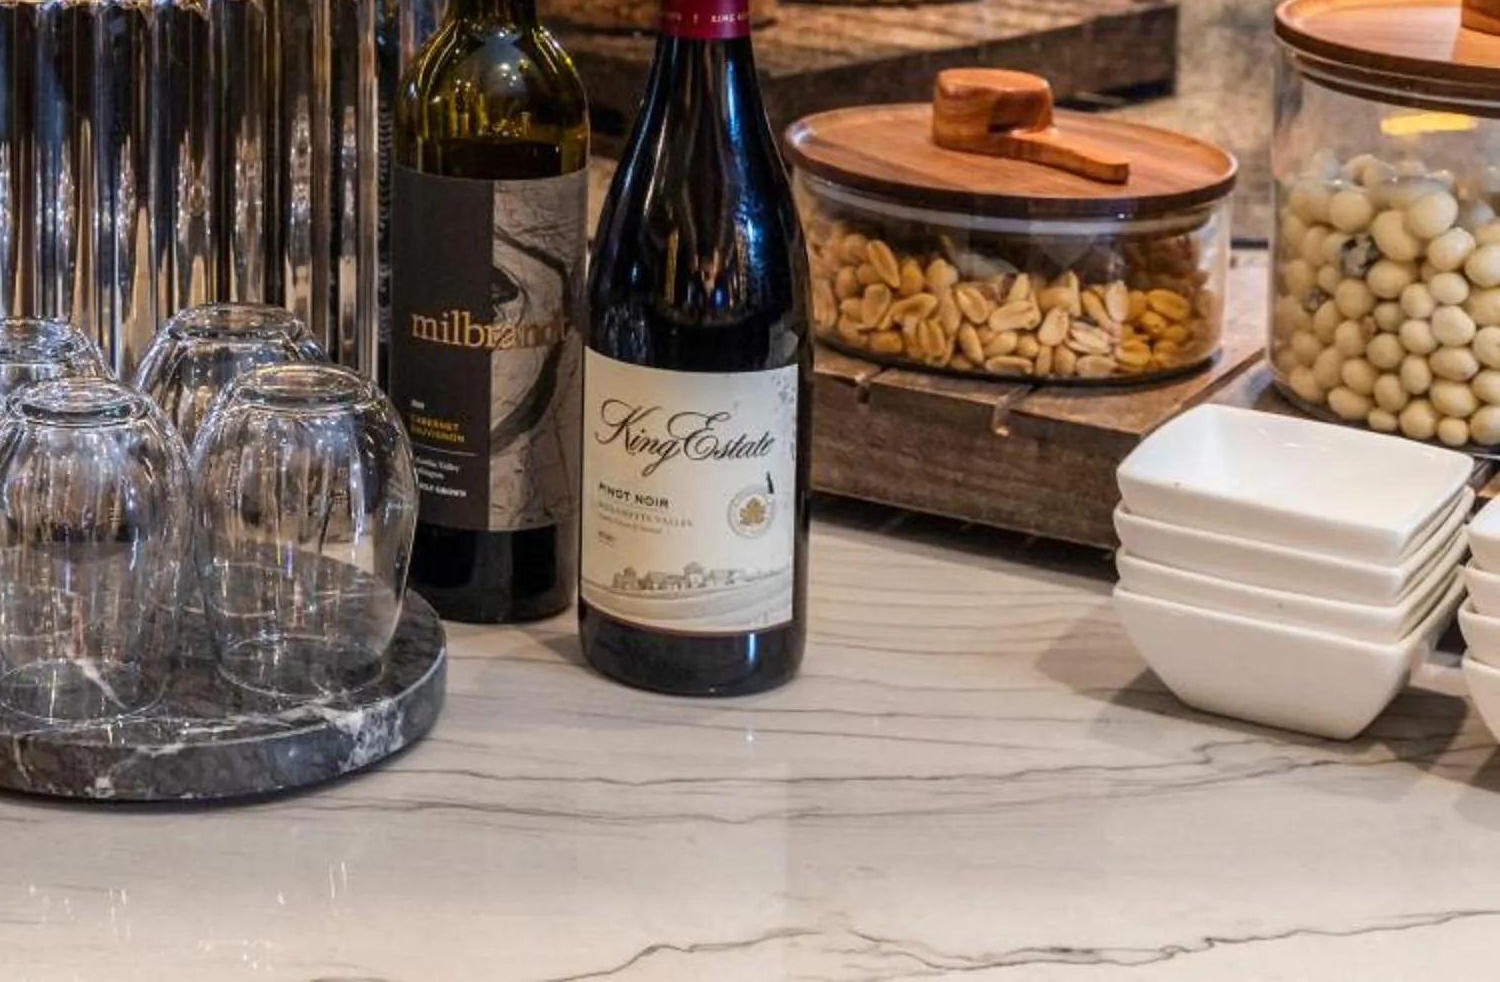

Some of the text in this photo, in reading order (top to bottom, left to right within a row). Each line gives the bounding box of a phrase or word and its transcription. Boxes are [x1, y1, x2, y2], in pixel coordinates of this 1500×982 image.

[594, 398, 775, 477] King Estate
[634, 493, 670, 509] NOIR
